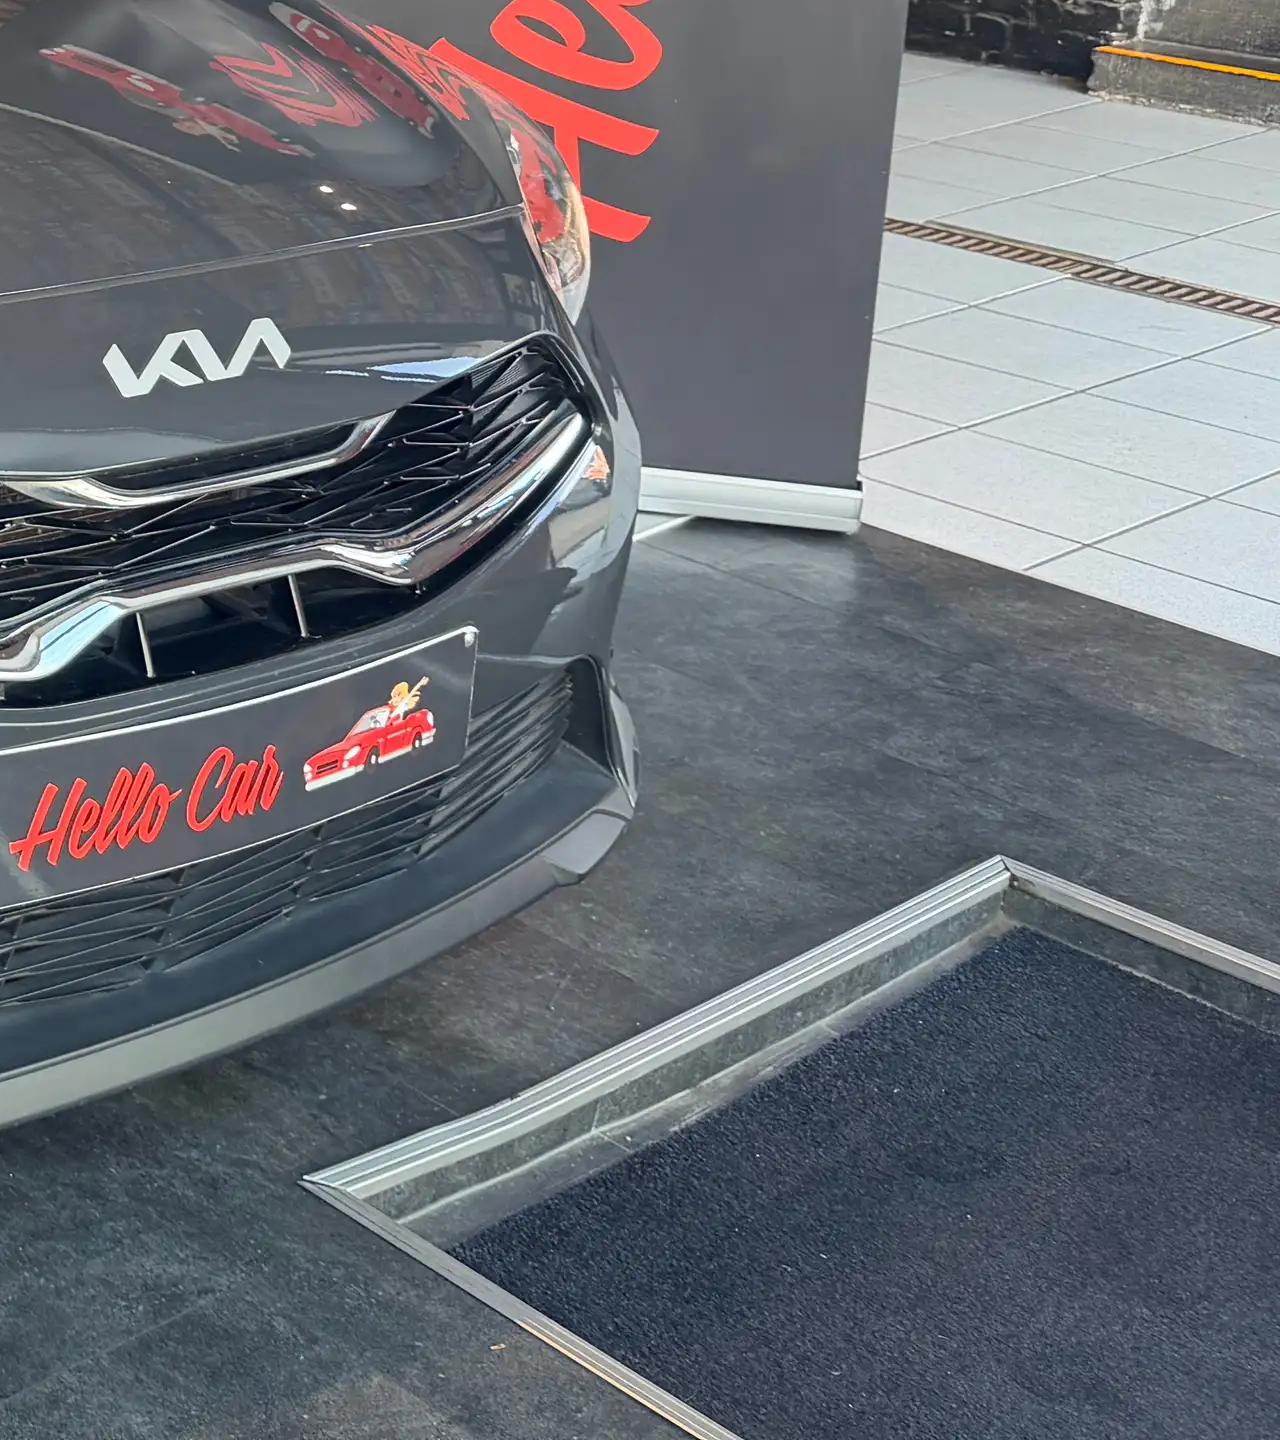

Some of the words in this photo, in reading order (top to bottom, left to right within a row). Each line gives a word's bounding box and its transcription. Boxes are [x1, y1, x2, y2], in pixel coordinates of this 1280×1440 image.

[102, 316, 293, 399] KIA
[9, 759, 183, 872] Hello
[184, 743, 285, 833] Car
